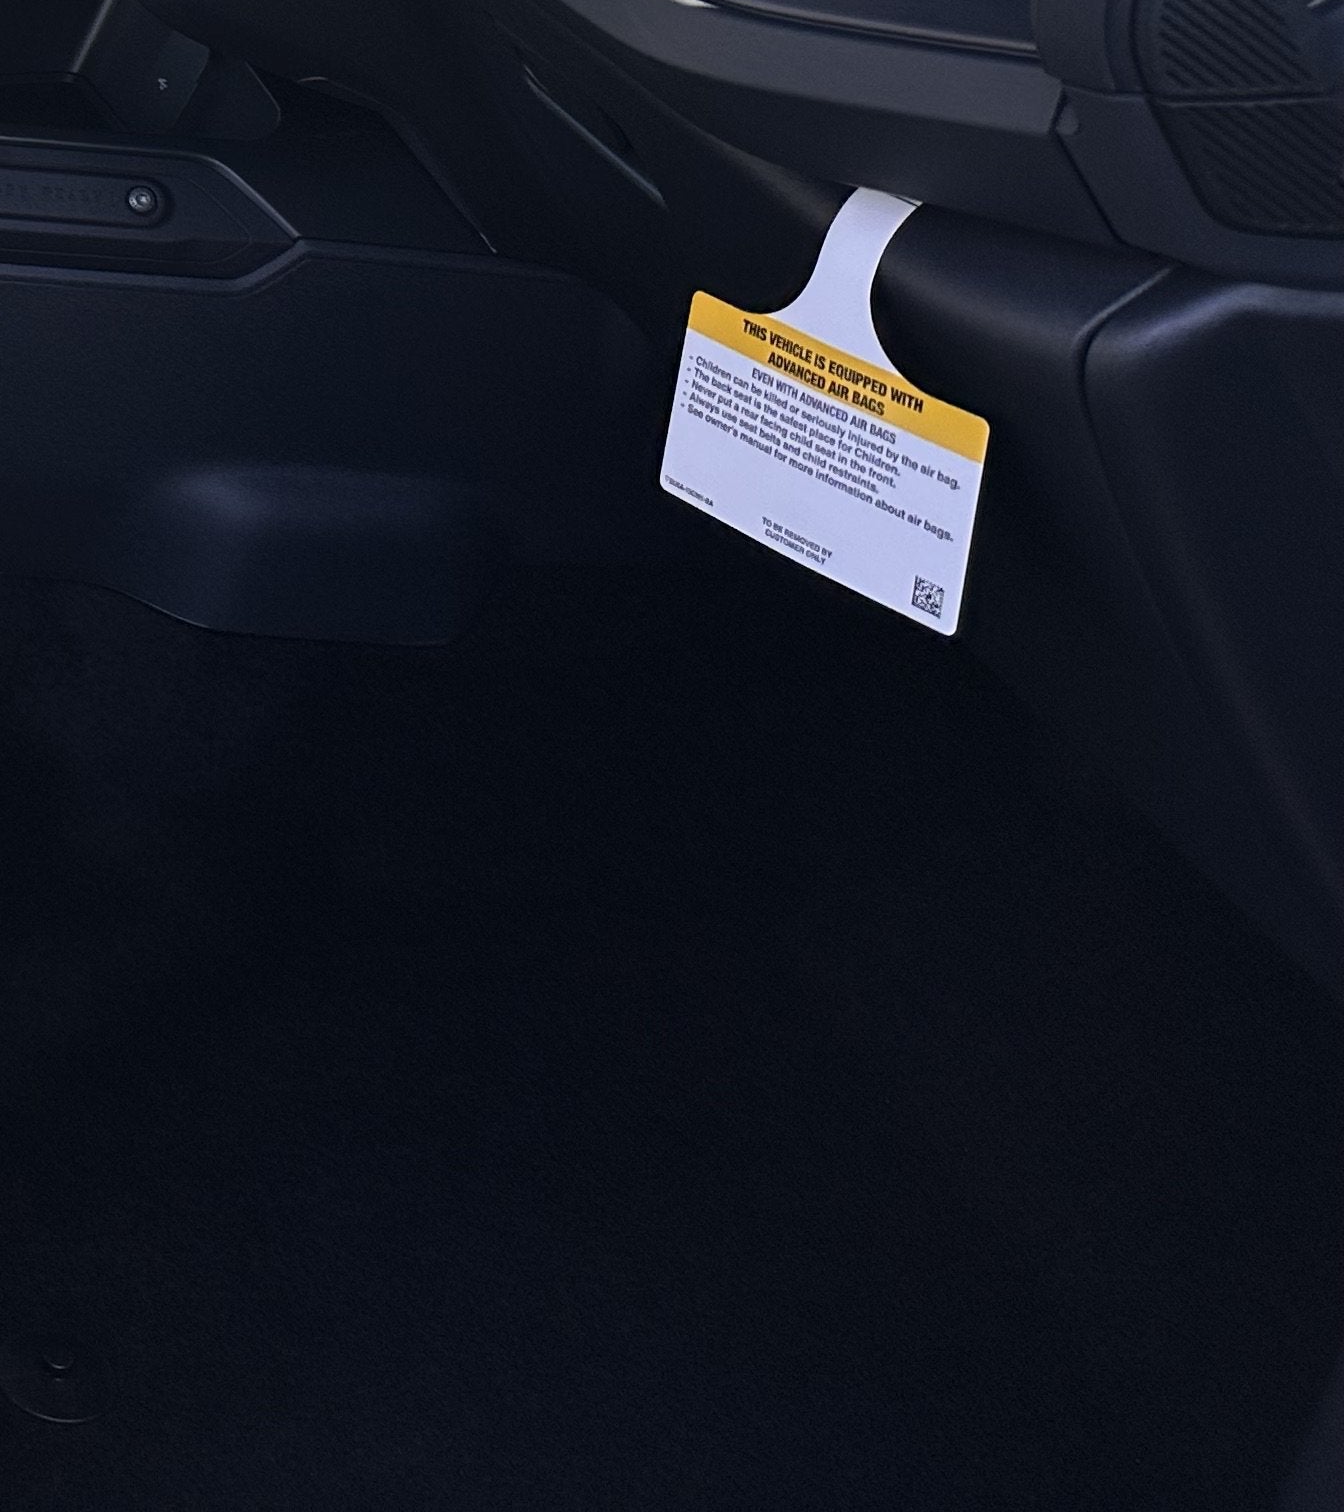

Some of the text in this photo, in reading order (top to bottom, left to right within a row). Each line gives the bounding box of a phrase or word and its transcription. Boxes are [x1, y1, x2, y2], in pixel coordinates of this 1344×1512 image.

[742, 319, 923, 413] THIS VEHICLE IS EQUIPPED WITH
[752, 368, 896, 444] EVEN WITH ADVANCED AIR BAGS
[768, 351, 885, 416] ADVANCED AIR BAGS
[689, 391, 879, 493] Always use seat belts and child restraints.
[692, 379, 715, 398] Never
[717, 394, 732, 409] put
[741, 406, 758, 420] rear
[760, 415, 787, 438] facing
[789, 429, 812, 448] child
[815, 442, 835, 459] seat
[850, 458, 866, 473] the
[868, 466, 896, 488] front.
[694, 368, 709, 383] The
[711, 377, 731, 394] back
[733, 388, 751, 404] seat
[764, 403, 777, 417] the
[779, 411, 807, 432] safest
[809, 426, 835, 447] place
[838, 439, 852, 453] for
[854, 446, 900, 476] Children.
[695, 355, 731, 380] Children
[733, 377, 748, 389] can
[751, 383, 762, 396] be
[764, 390, 787, 409] killed
[801, 409, 844, 438] seriously
[848, 430, 883, 456] injured
[885, 448, 899, 463] by
[901, 455, 917, 470] the
[920, 462, 934, 478] air
[937, 470, 960, 492] bag.
[687, 403, 953, 544] See owner's manual for more information about air bags.
[761, 517, 771, 527] TO
[784, 528, 819, 552] REMOVED
[821, 547, 831, 558] BY
[765, 528, 825, 565] CUSTOMER ONLY
